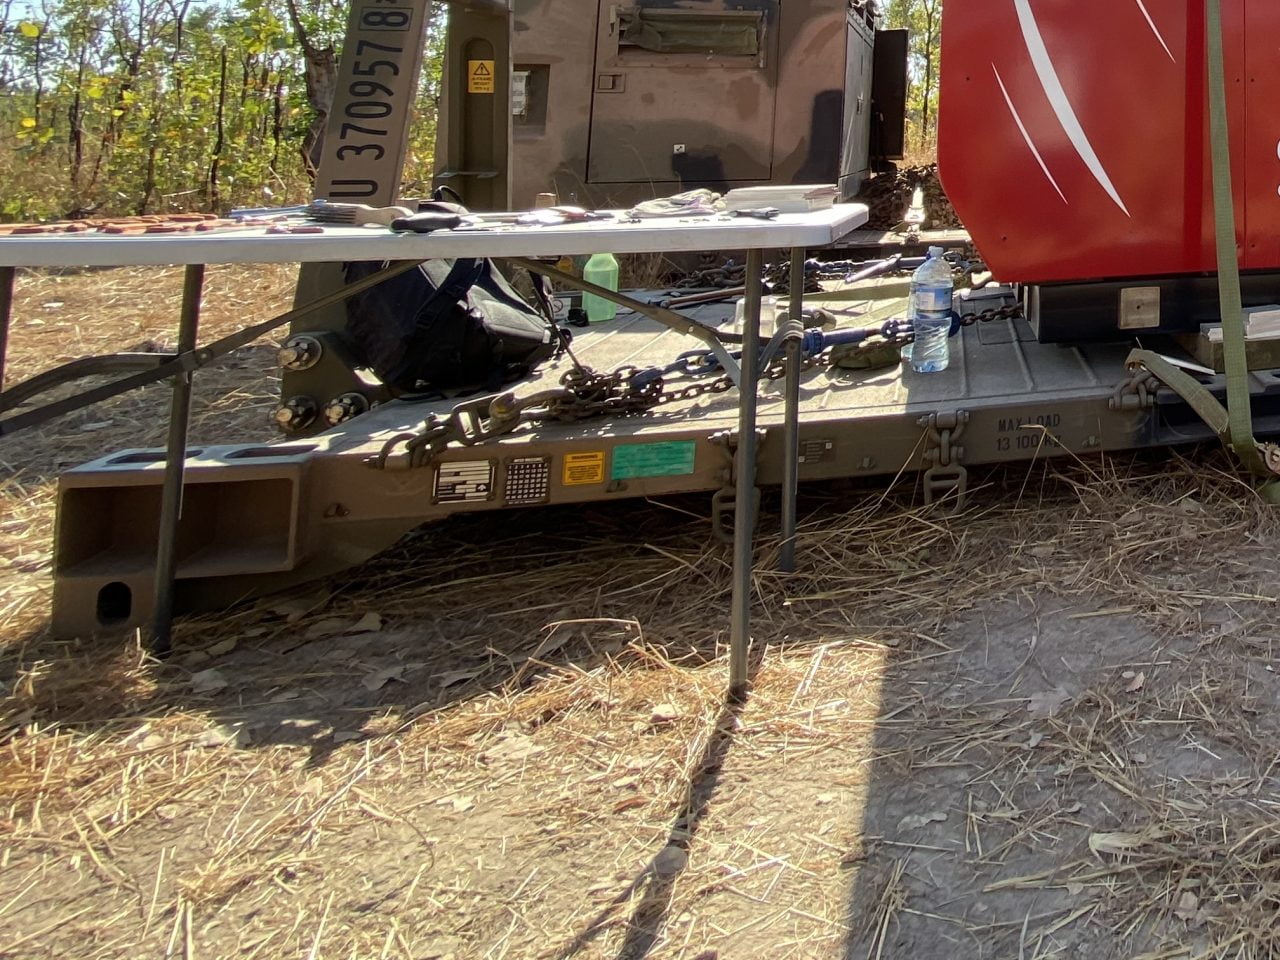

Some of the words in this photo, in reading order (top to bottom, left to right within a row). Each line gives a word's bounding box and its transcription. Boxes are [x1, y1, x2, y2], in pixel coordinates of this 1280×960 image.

[362, 11, 409, 27] 8
[336, 40, 403, 161] 370957
[328, 179, 379, 198] U
[998, 417, 1022, 432] MAX
[1016, 434, 1040, 449] 100
